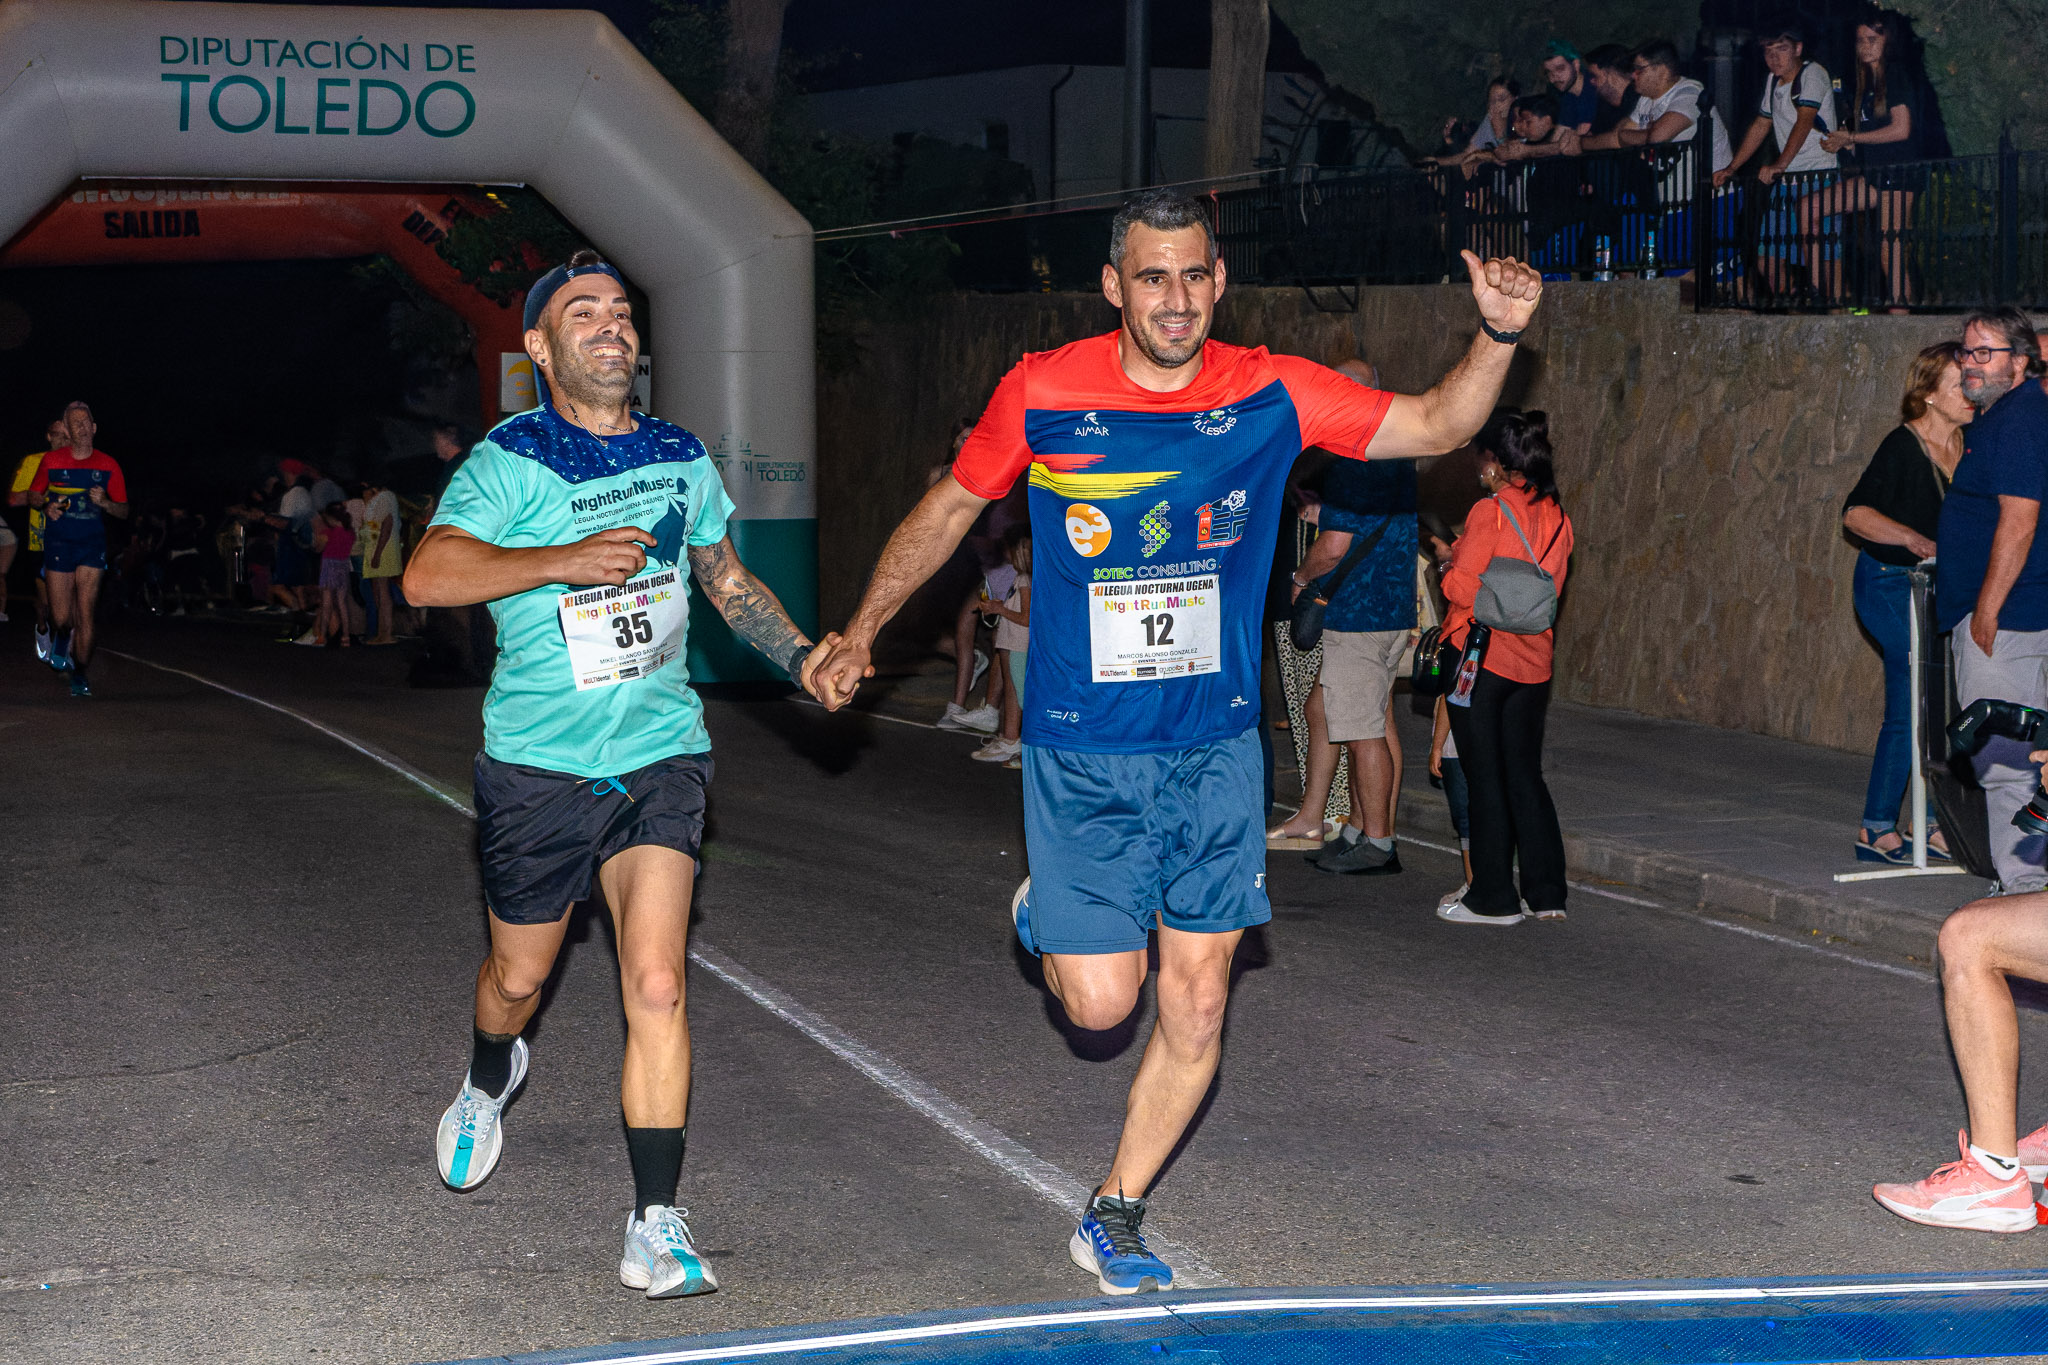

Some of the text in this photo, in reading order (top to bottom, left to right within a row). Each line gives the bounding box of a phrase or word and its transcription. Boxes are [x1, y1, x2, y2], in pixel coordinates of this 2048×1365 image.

[160, 35, 476, 73] DIPUTACIÓN DE
[161, 73, 476, 138] TOLEDO
[104, 209, 200, 239] SALIDA
[1192, 416, 1237, 436] ILLESCAS
[758, 469, 806, 481] TOLEDO
[574, 514, 595, 525] LEGUA
[596, 507, 624, 520] NOCTURNA
[1093, 558, 1216, 580] SOTEC CONSULTING
[564, 572, 676, 608] XI LEGUA NOCTURNA UGENA
[1094, 586, 1104, 597] XI
[1104, 584, 1133, 597] LEGUA
[1134, 581, 1185, 595] NOCTURNA
[1186, 579, 1214, 591] UGENA
[612, 611, 653, 649] 35
[1141, 613, 1174, 646] 12
[1100, 669, 1127, 677] MULTIdental
